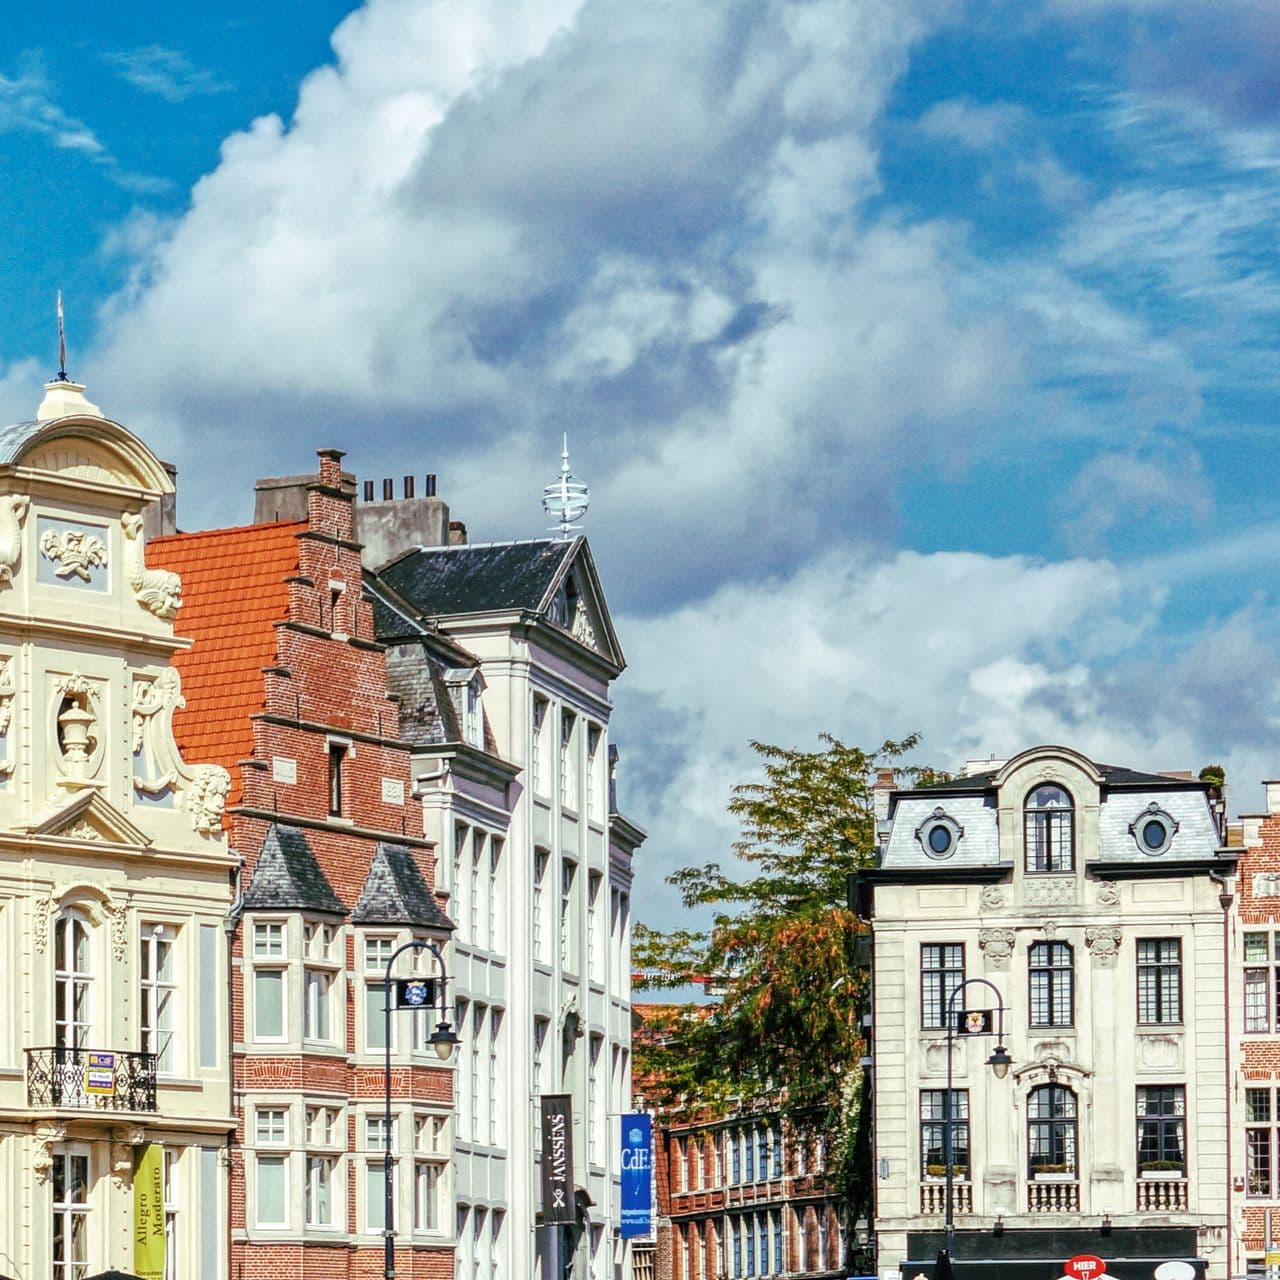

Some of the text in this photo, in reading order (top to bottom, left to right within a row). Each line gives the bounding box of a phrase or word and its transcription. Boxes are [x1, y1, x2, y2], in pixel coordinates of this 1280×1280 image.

[547, 1114, 566, 1182] JANSSENS
[137, 1193, 151, 1245] Allegro
[152, 1167, 163, 1236] Moderato
[1073, 1261, 1097, 1271] HIER
